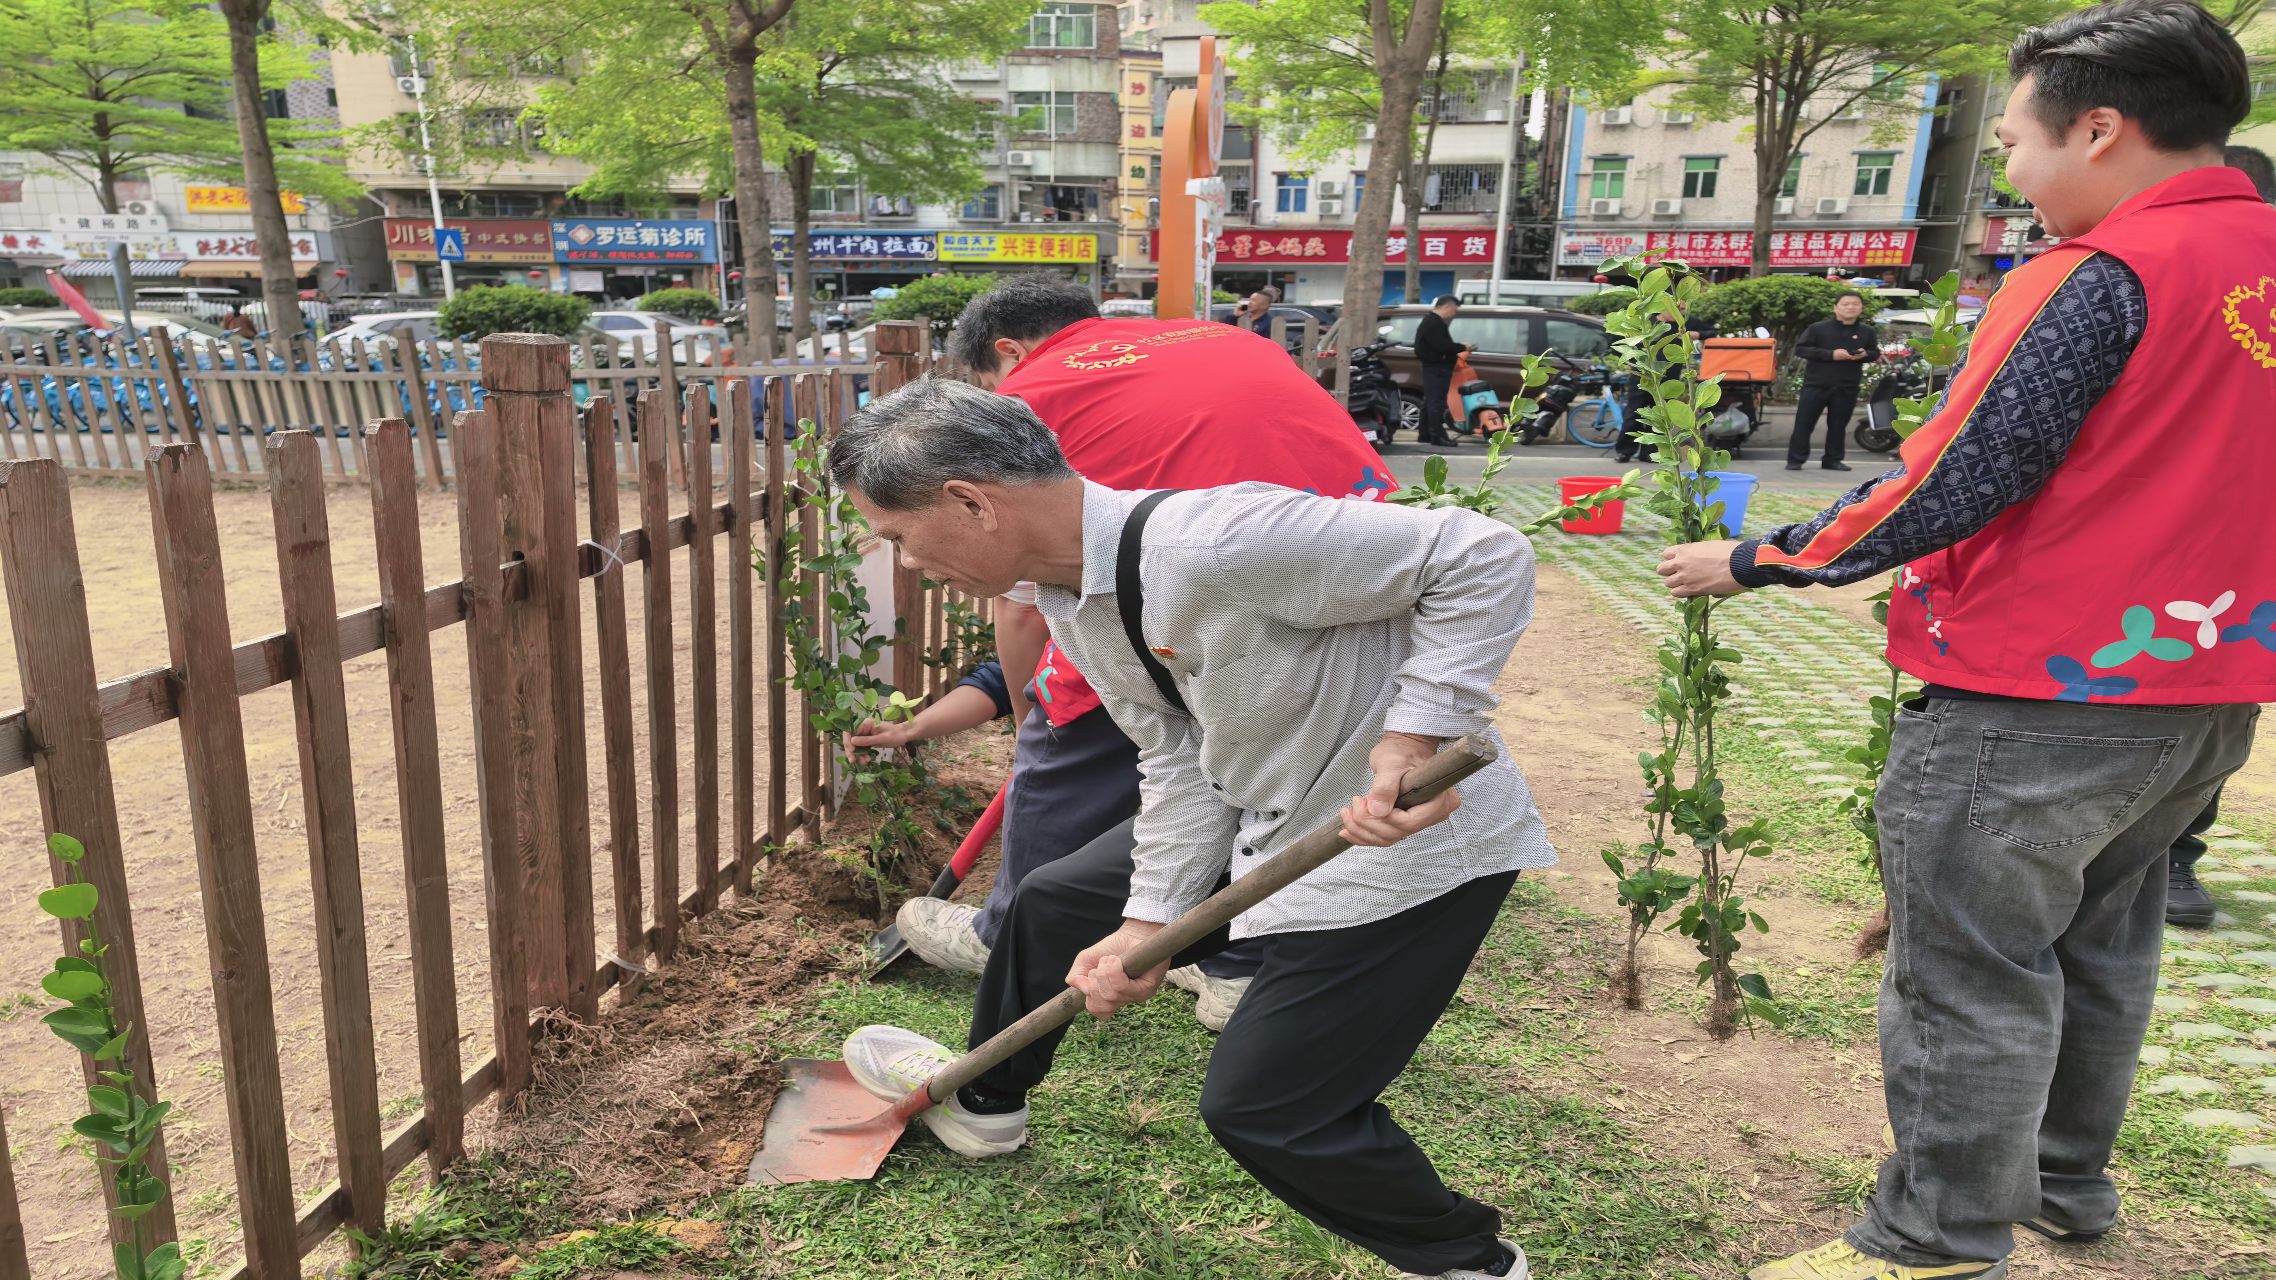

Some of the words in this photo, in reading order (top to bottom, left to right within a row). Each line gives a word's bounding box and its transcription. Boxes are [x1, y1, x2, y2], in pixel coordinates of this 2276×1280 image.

[190, 189, 298, 207] 洪老七酒家
[197, 236, 314, 256] 洪老七酒家
[596, 226, 706, 247] 罗运菊诊所
[792, 235, 930, 255] 州牛肉拉面
[1652, 231, 1908, 249] 深圳市永群盛蛋品有限公司
[1002, 237, 1092, 259] 兴洋便利店
